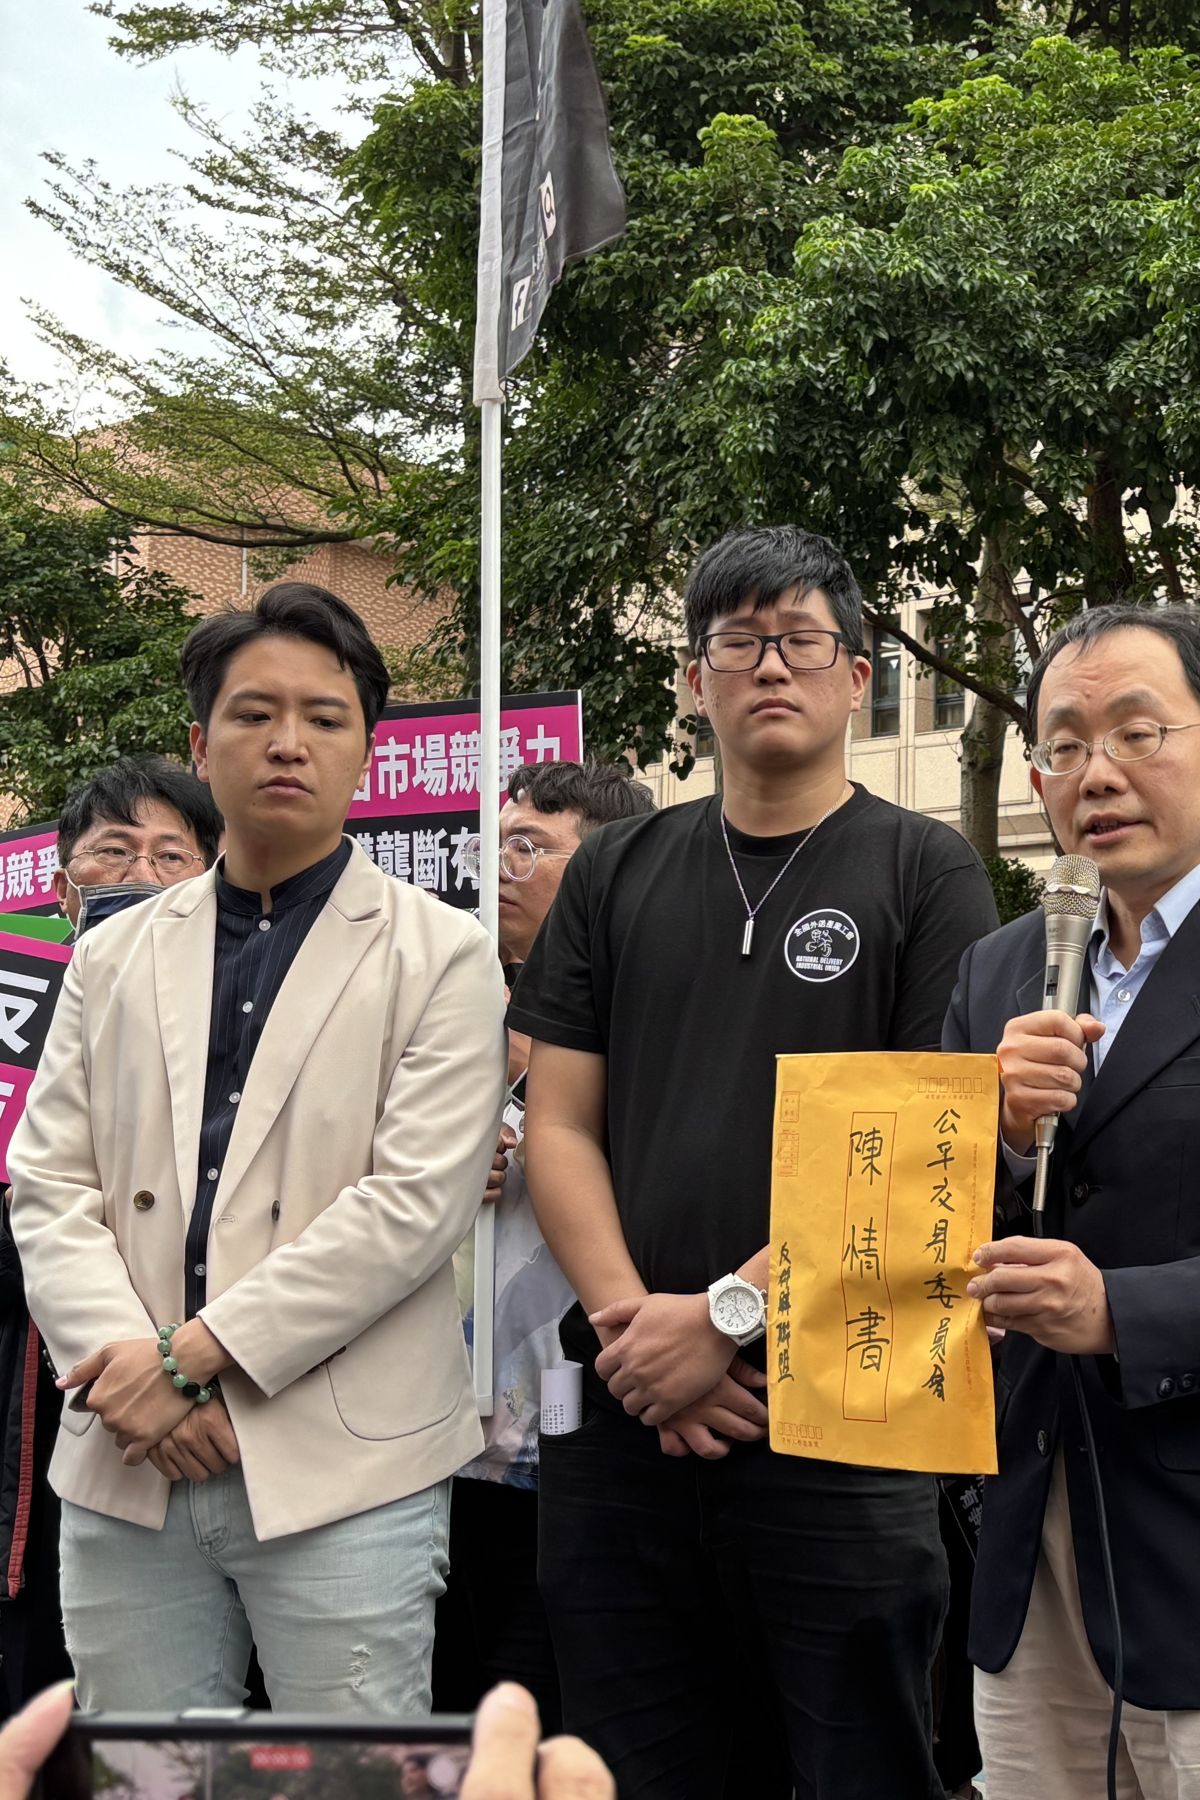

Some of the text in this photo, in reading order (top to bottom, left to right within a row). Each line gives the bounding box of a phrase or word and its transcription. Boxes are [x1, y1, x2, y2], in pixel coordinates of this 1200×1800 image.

[354, 724, 561, 802] 市場競爭力
[0, 846, 61, 901] 競爭
[843, 1126, 890, 1373] 陳情書
[921, 1108, 962, 1402] 公平交易委員會
